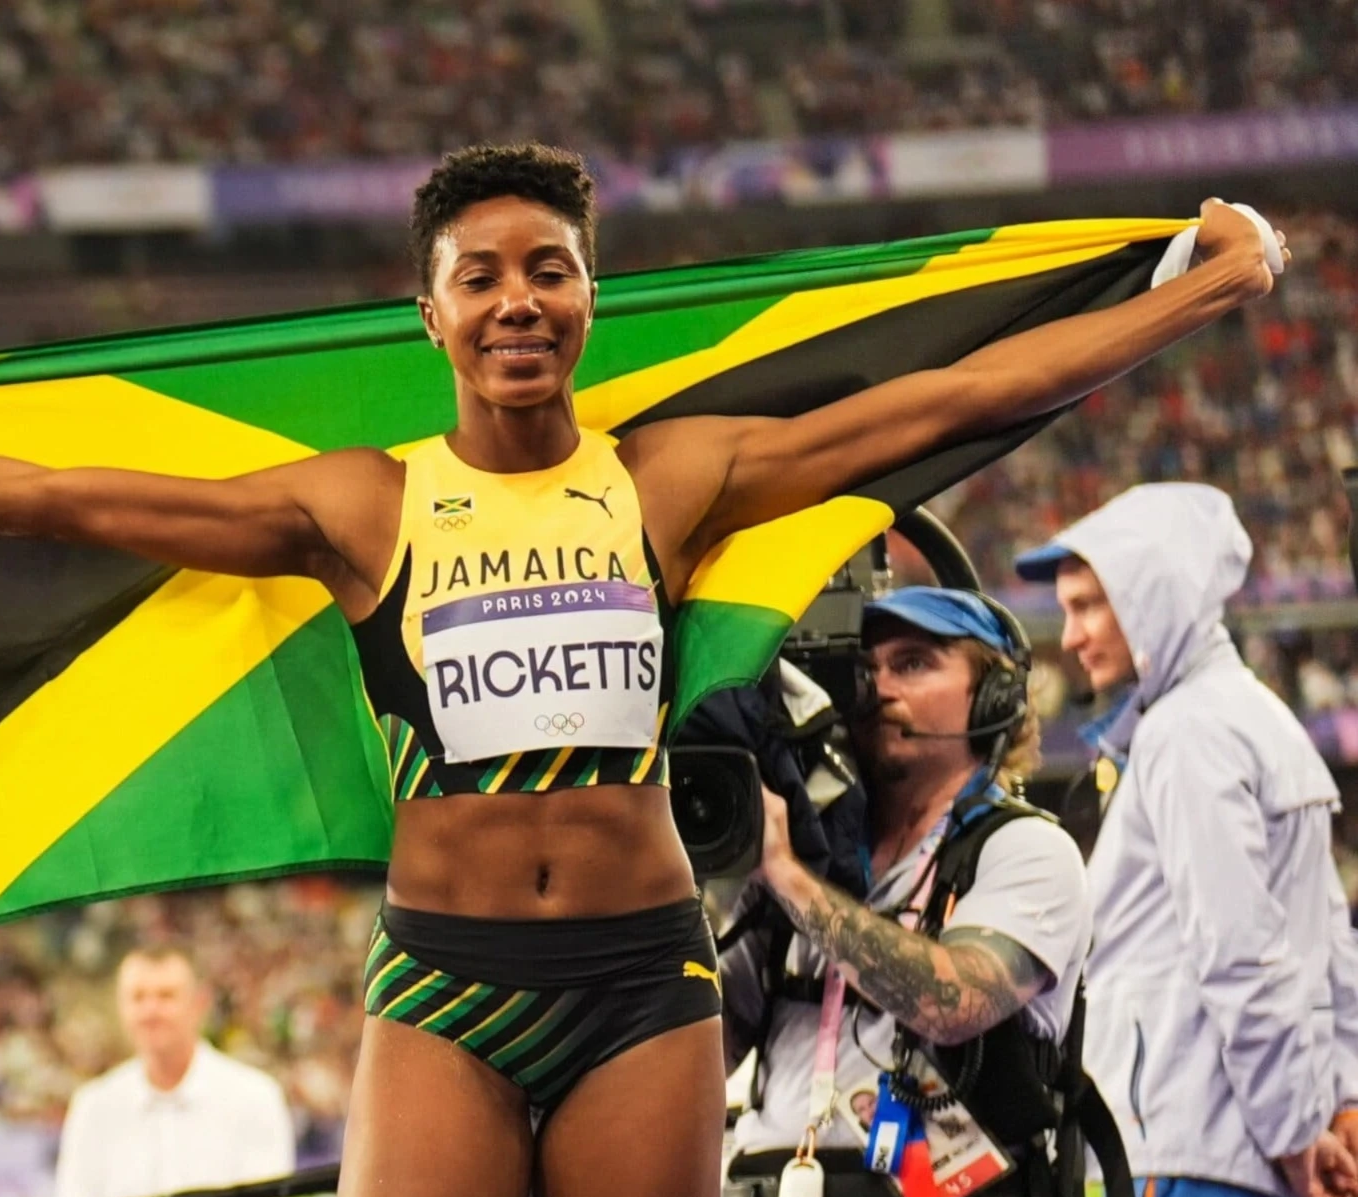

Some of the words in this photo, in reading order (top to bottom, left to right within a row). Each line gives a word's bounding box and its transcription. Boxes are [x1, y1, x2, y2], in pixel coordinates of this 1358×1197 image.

[421, 546, 630, 598] JAMAICA
[483, 594, 543, 613] PARIS
[551, 588, 605, 607] 2024
[435, 641, 656, 708] RICKETTS
